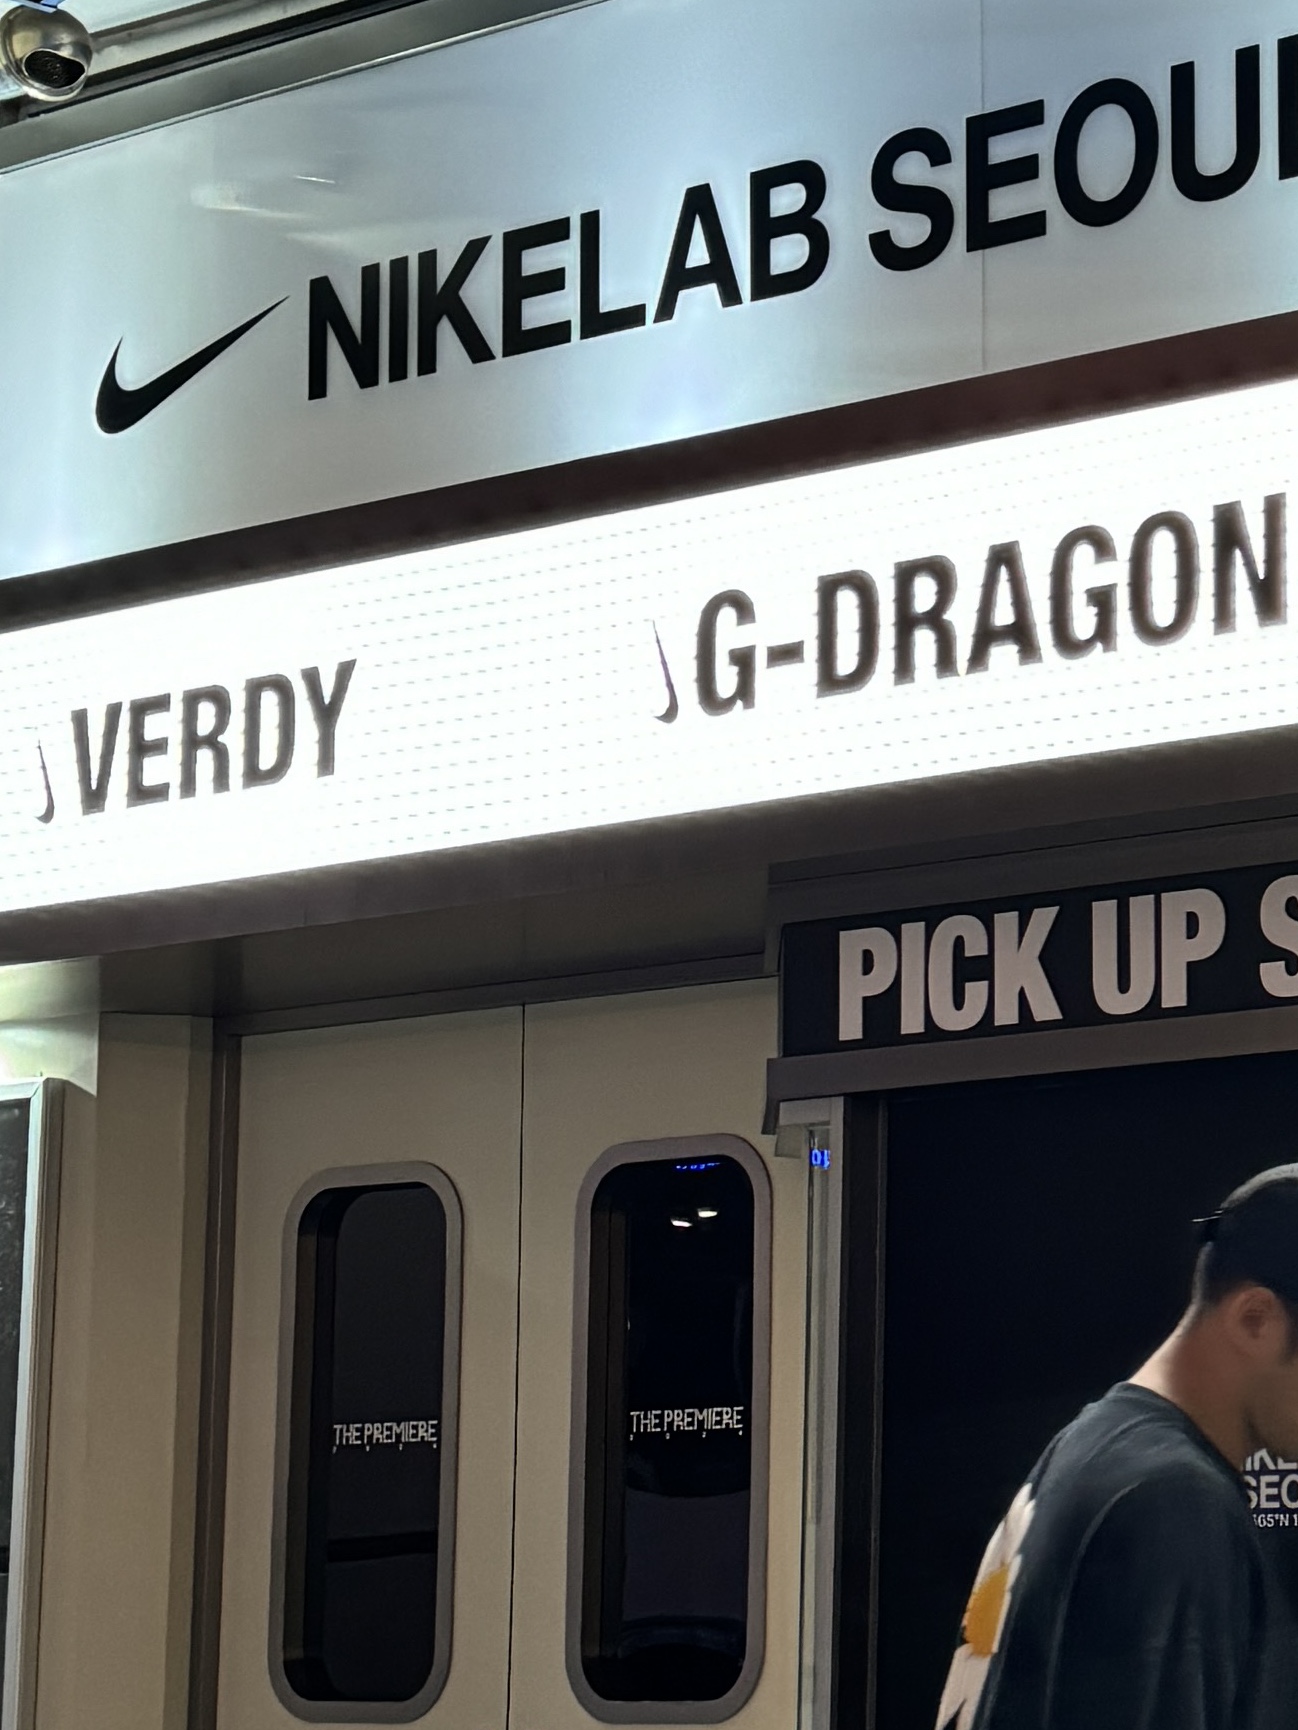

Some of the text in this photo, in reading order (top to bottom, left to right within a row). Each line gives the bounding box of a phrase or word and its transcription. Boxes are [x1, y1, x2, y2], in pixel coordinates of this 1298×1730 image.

[307, 159, 831, 401] NIKELAB
[694, 492, 1288, 717] G-DRAGON
[71, 658, 358, 817] VERDY
[838, 906, 1062, 1042] PICK
[1091, 888, 1226, 1016] UP
[333, 1420, 438, 1446] THE PREMIERE
[630, 1406, 744, 1433] THE PREMIERE
